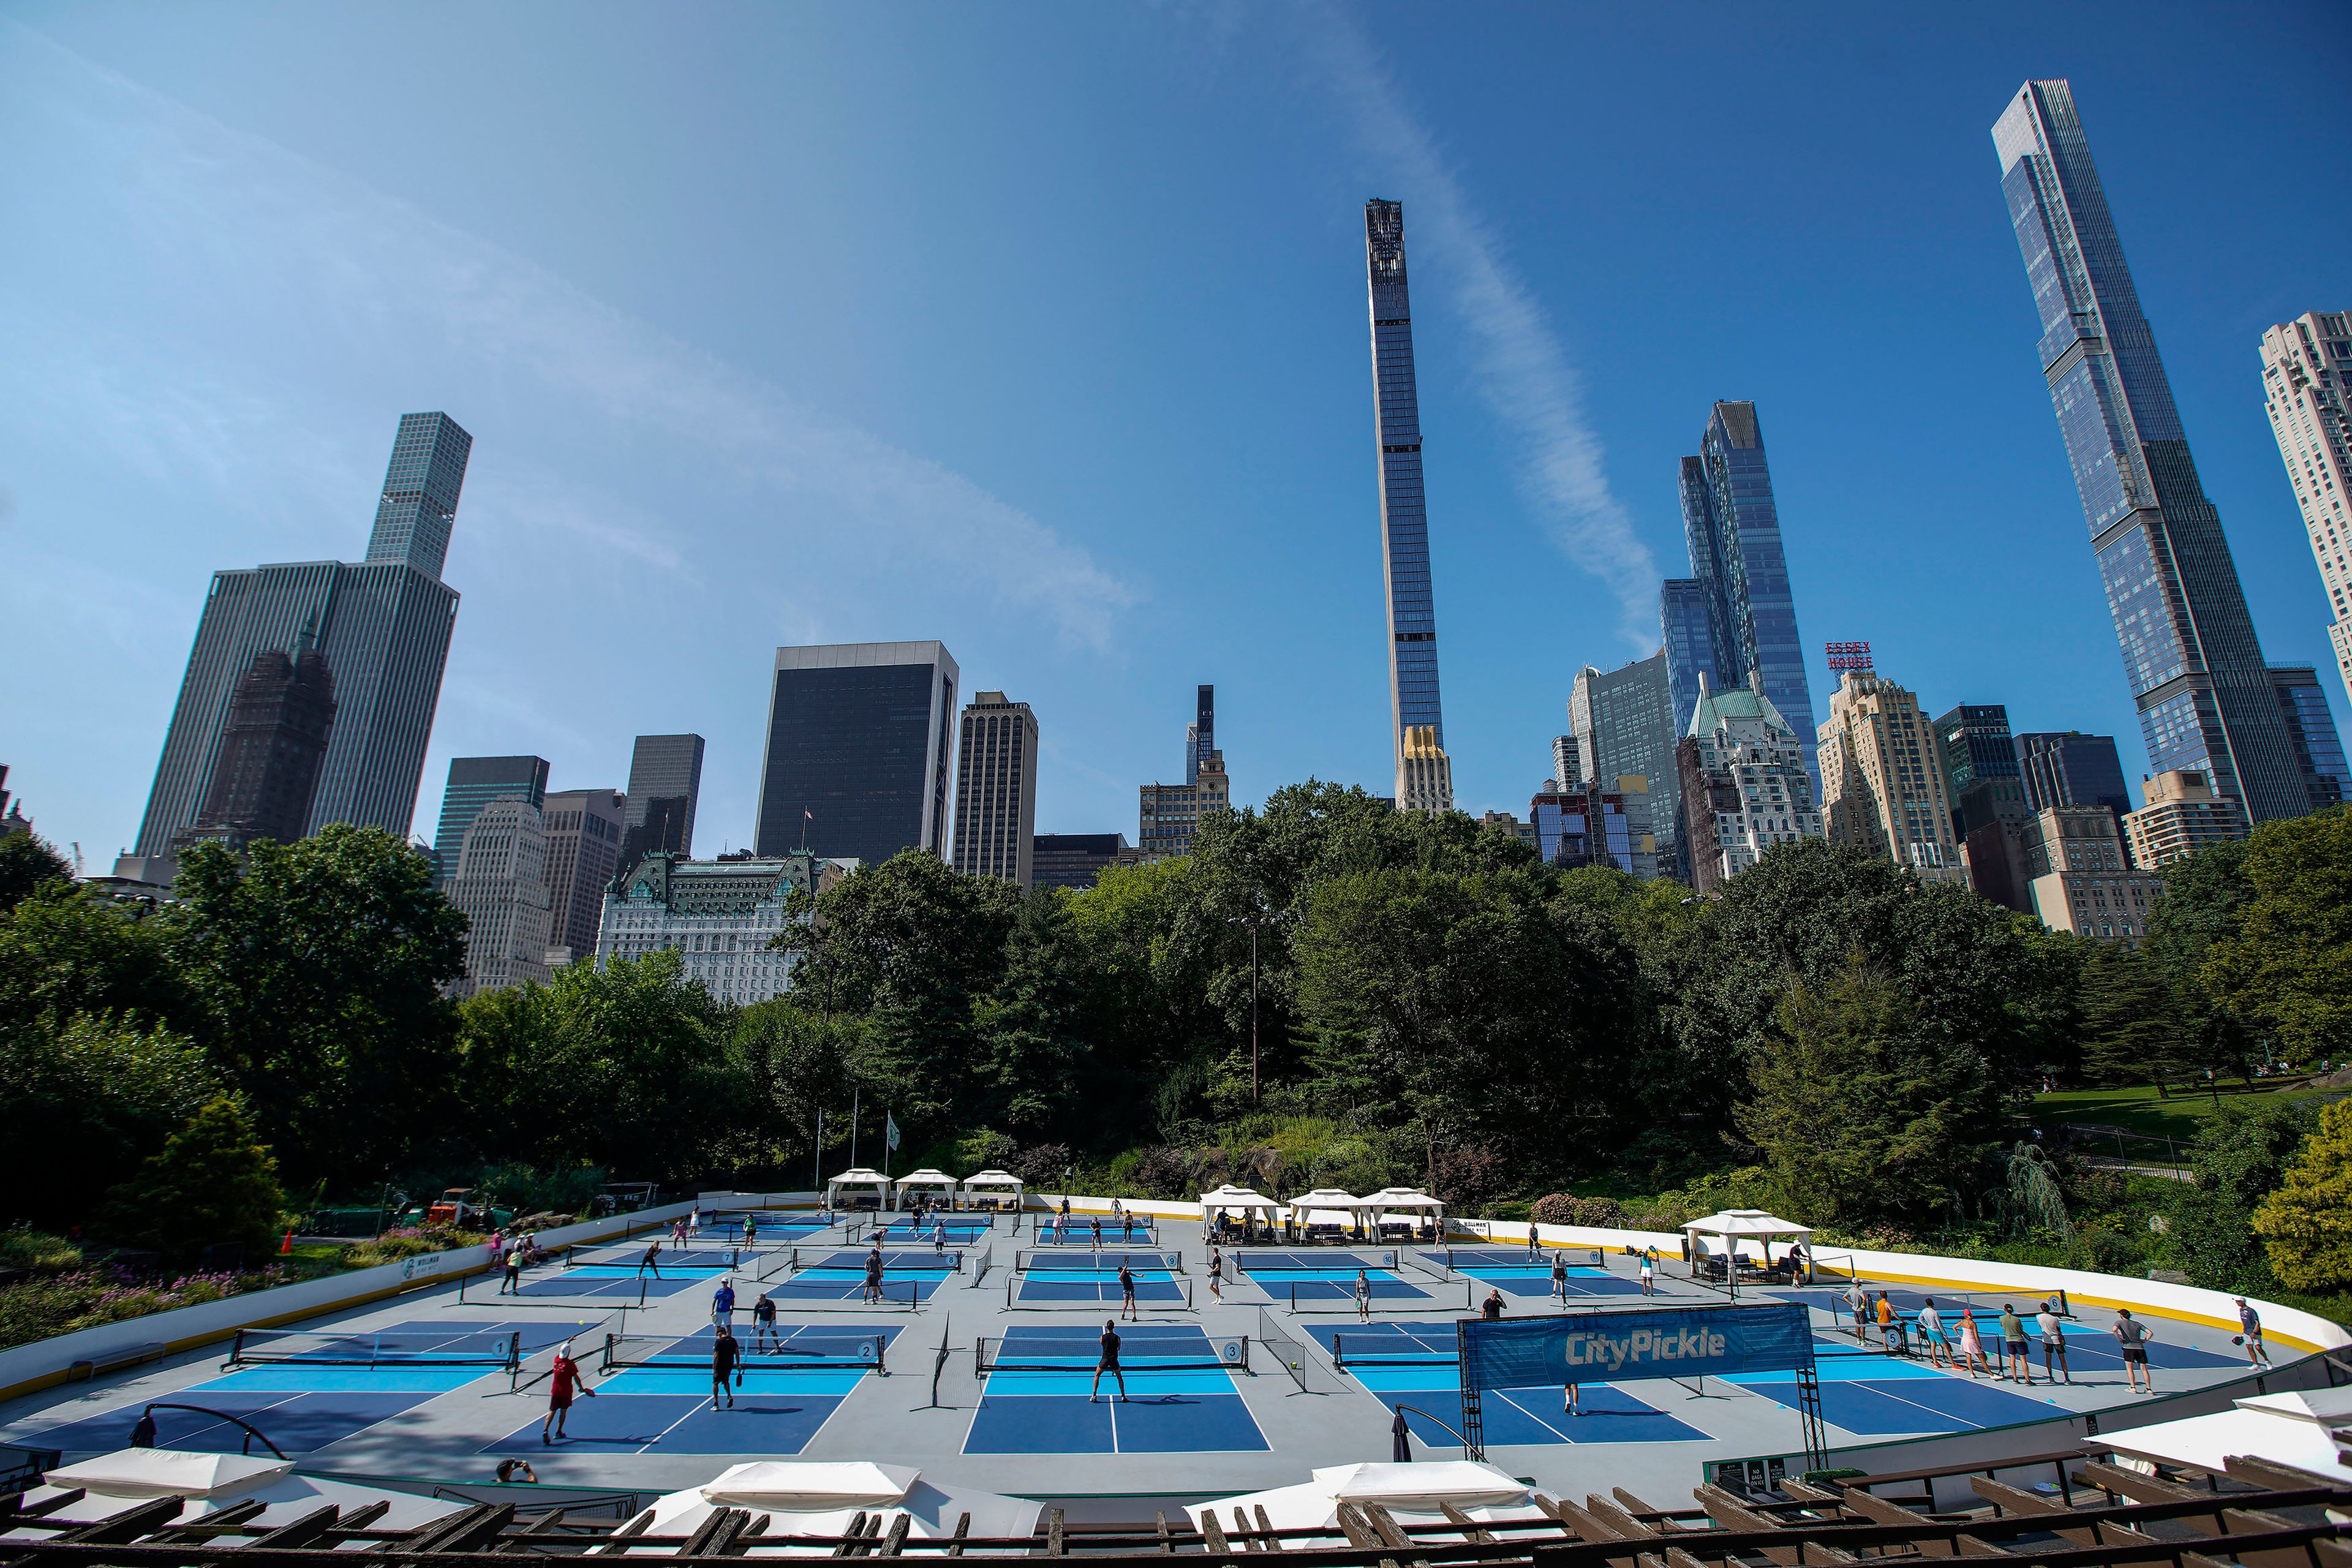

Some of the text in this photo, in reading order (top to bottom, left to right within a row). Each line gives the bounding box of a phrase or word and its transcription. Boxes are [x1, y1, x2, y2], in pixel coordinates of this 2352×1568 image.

[1826, 641, 1871, 653] ESSEX
[1828, 657, 1874, 668] HOUSE
[1890, 1333, 1895, 1343] 5
[497, 1343, 503, 1352] 1
[863, 1346, 870, 1357] 2
[1229, 1346, 1236, 1356] 3
[1566, 1327, 1725, 1371] CityPickle
